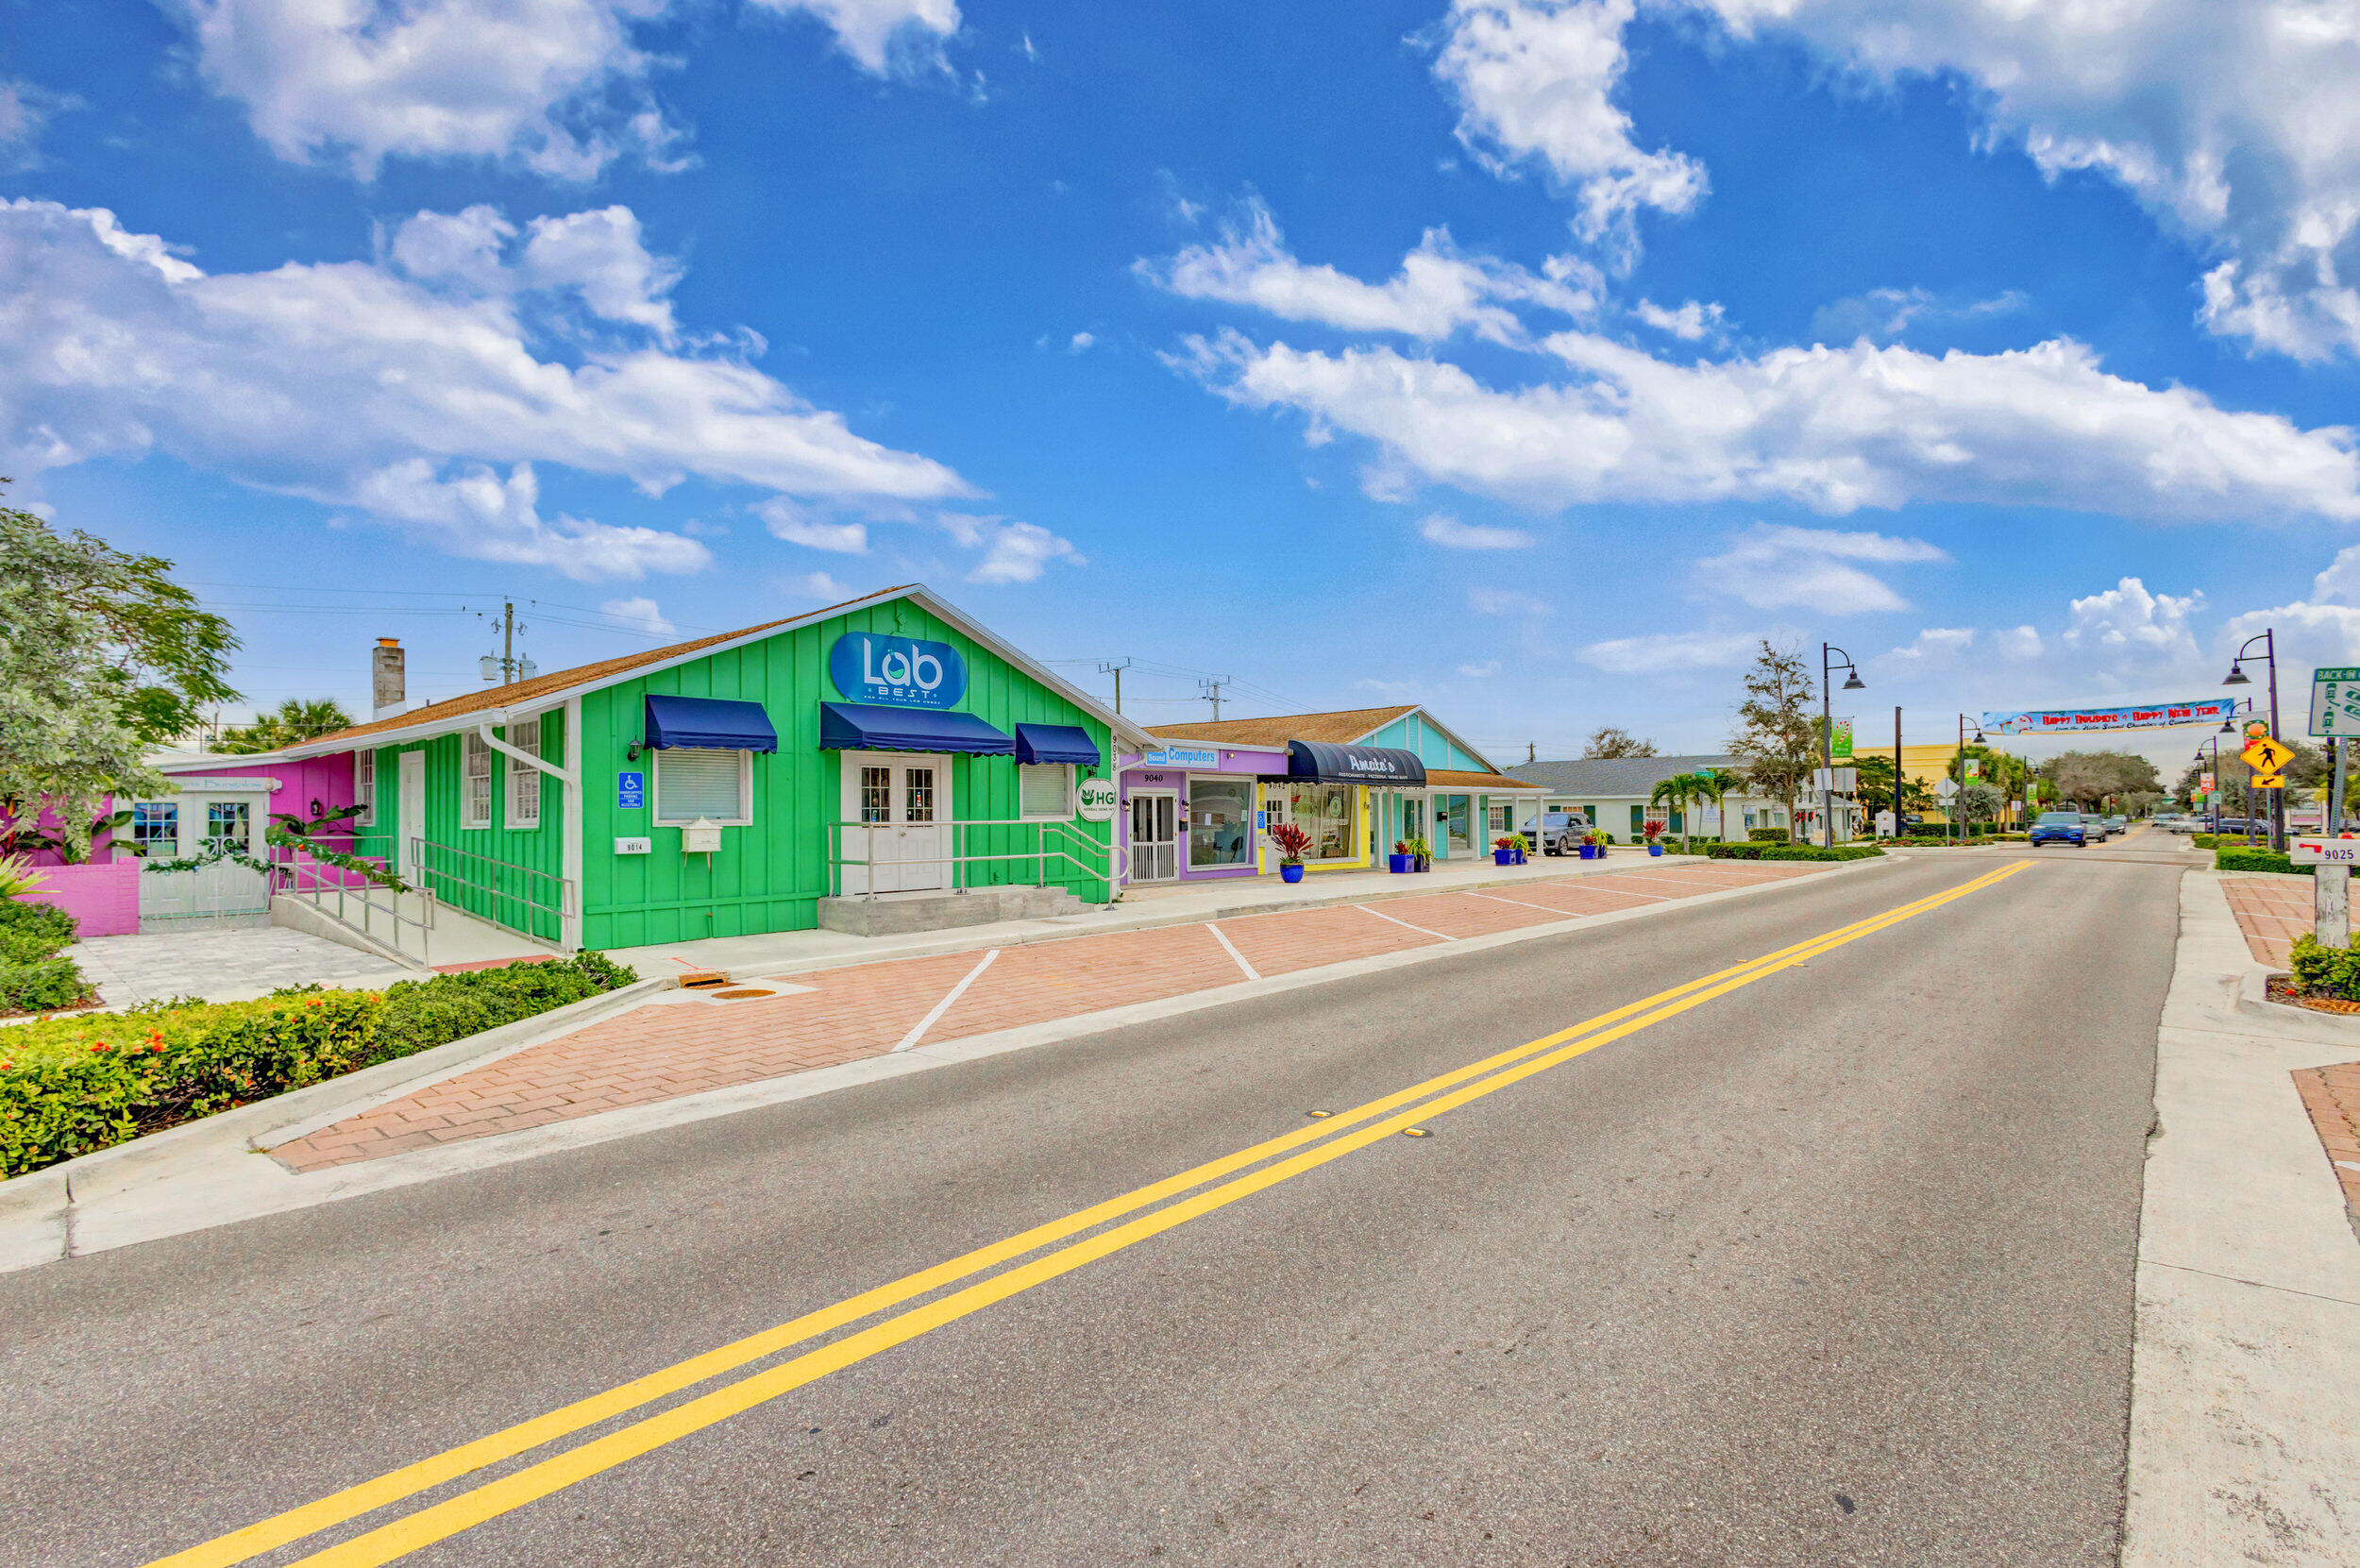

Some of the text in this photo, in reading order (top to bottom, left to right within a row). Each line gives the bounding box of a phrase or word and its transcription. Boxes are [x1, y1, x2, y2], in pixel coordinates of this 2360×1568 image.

[864, 637, 943, 690] Lab
[2318, 669, 2356, 680] BACK-IN
[878, 686, 930, 699] BEST
[1148, 747, 1215, 764] Sound Computers
[1349, 754, 1395, 773] Amato's
[1144, 774, 1164, 783] 9040
[2324, 849, 2354, 860] 9025
